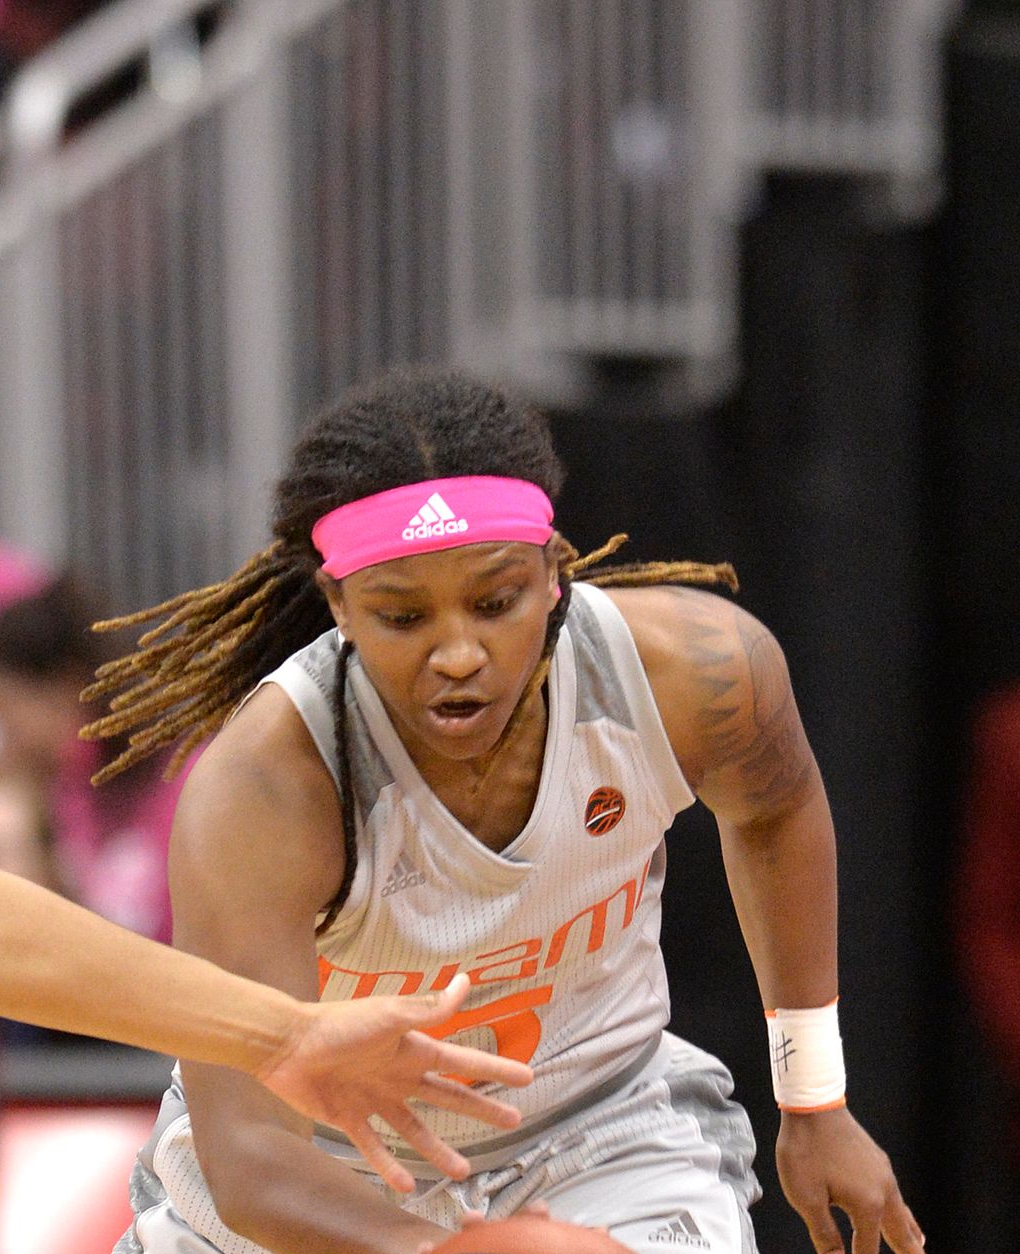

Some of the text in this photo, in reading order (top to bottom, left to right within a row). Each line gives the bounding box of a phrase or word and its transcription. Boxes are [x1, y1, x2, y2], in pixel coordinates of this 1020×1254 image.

[402, 518, 468, 541] adidas
[380, 872, 426, 898] adidas
[648, 1227, 711, 1250] adidas
